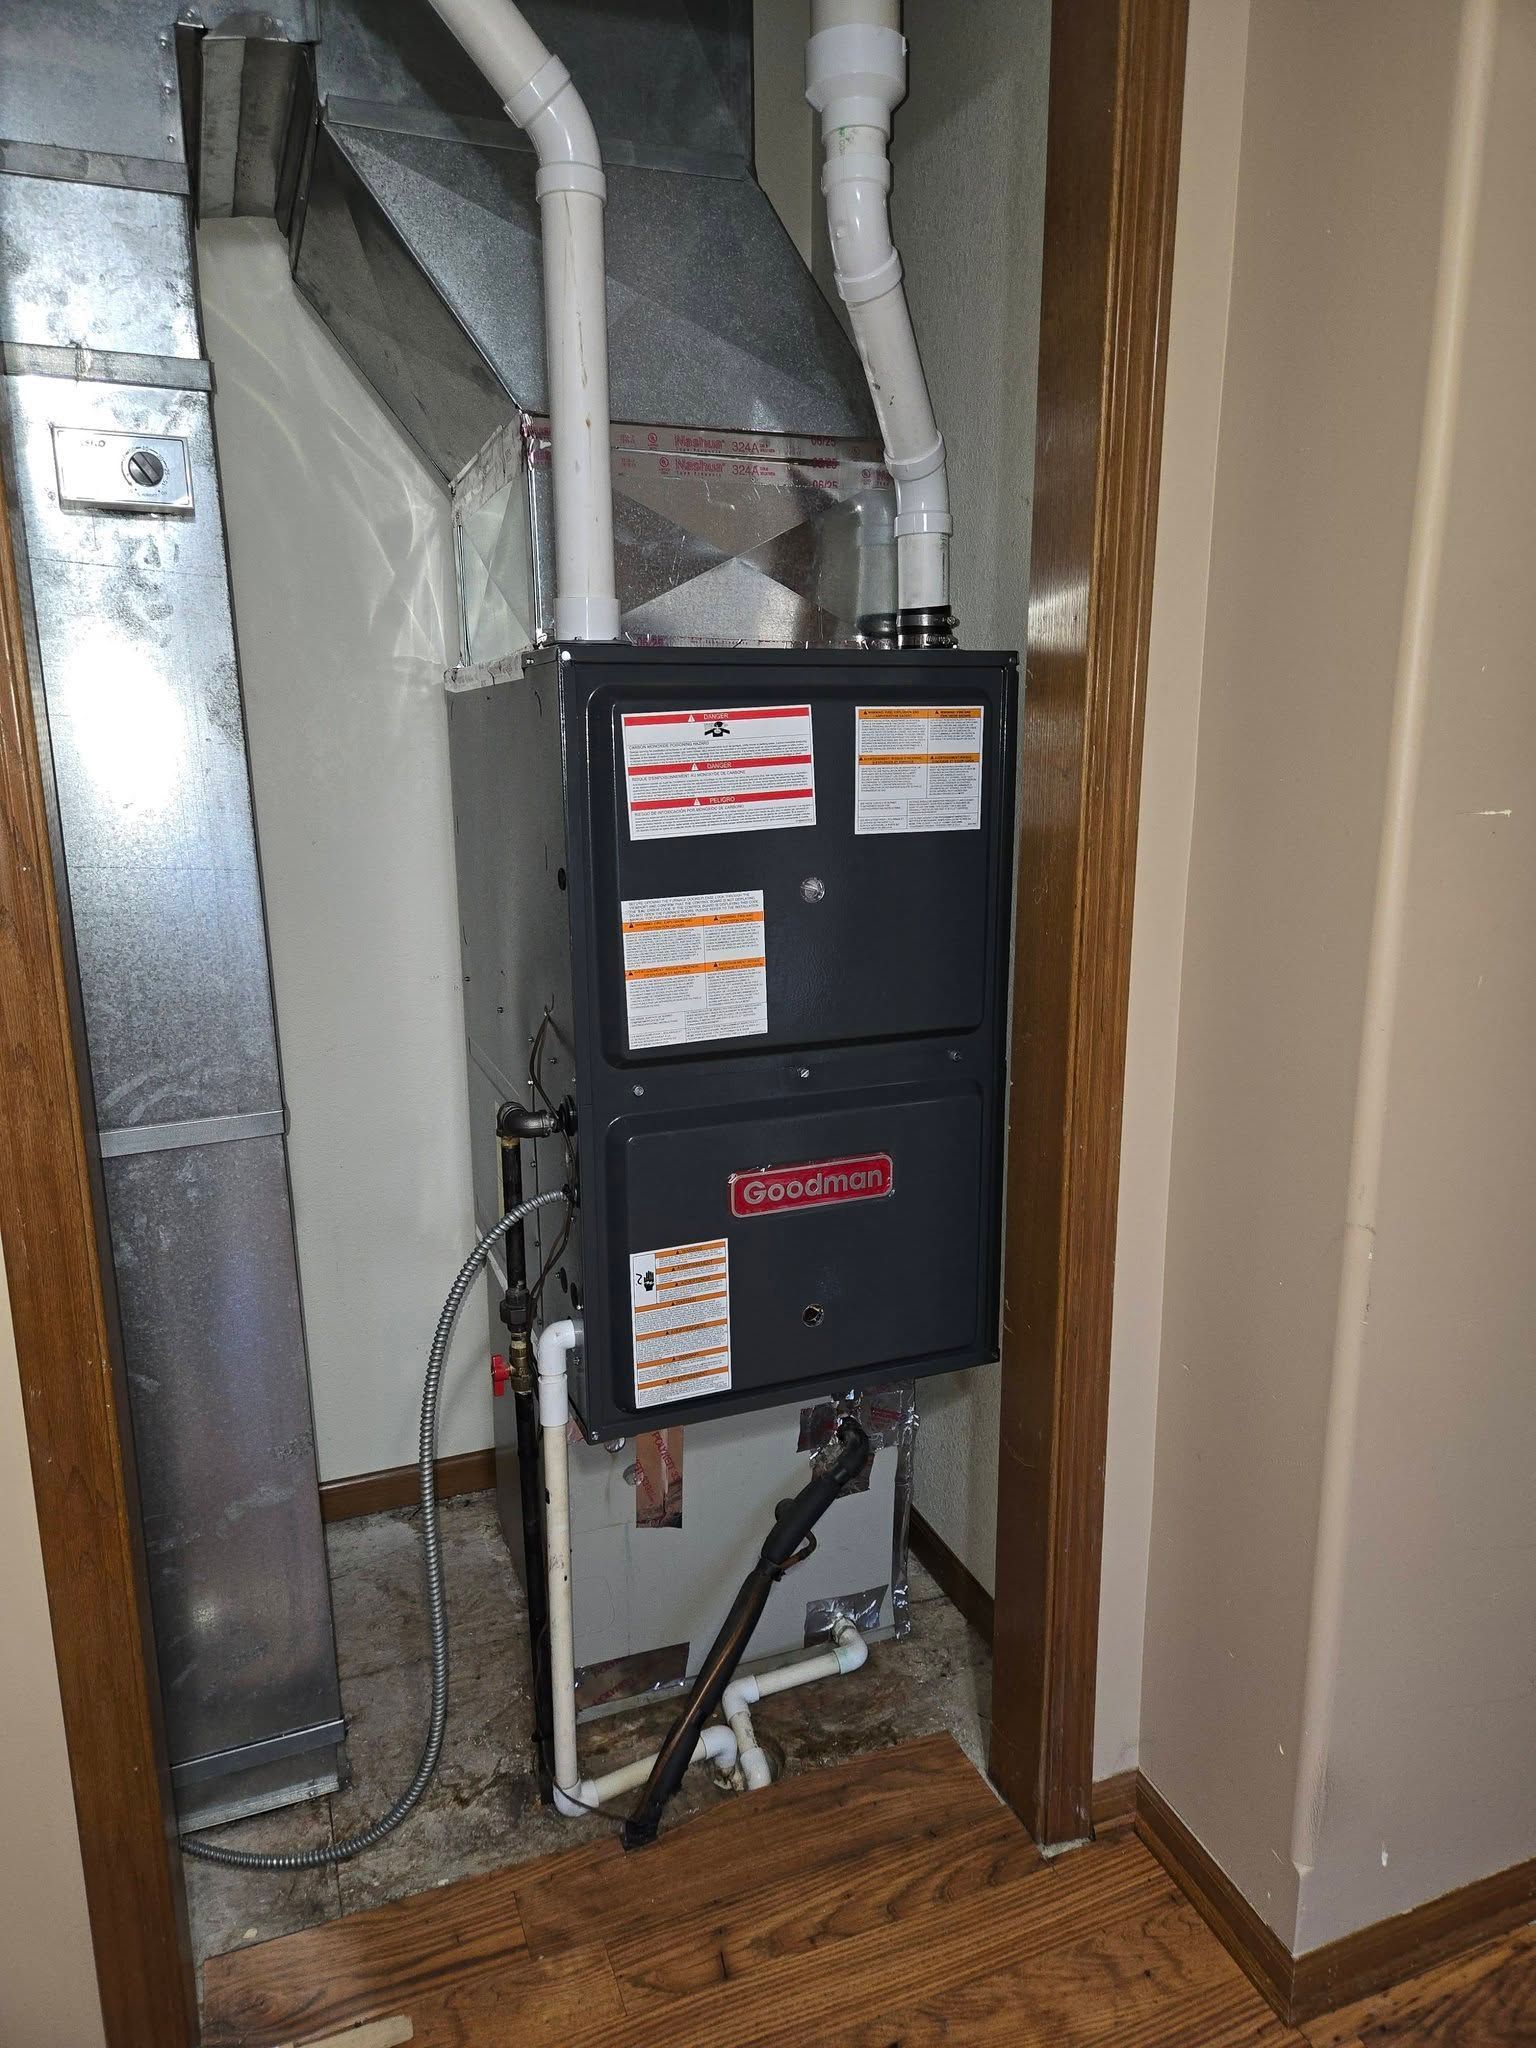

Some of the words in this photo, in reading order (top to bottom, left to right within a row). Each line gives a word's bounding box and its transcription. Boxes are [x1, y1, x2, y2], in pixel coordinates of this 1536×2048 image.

[732, 442, 759, 453] 324A
[732, 465, 759, 476] 324A
[703, 712, 729, 720] DANGER
[710, 796, 736, 804] PELIGRO
[743, 1168, 882, 1204] Goodman
